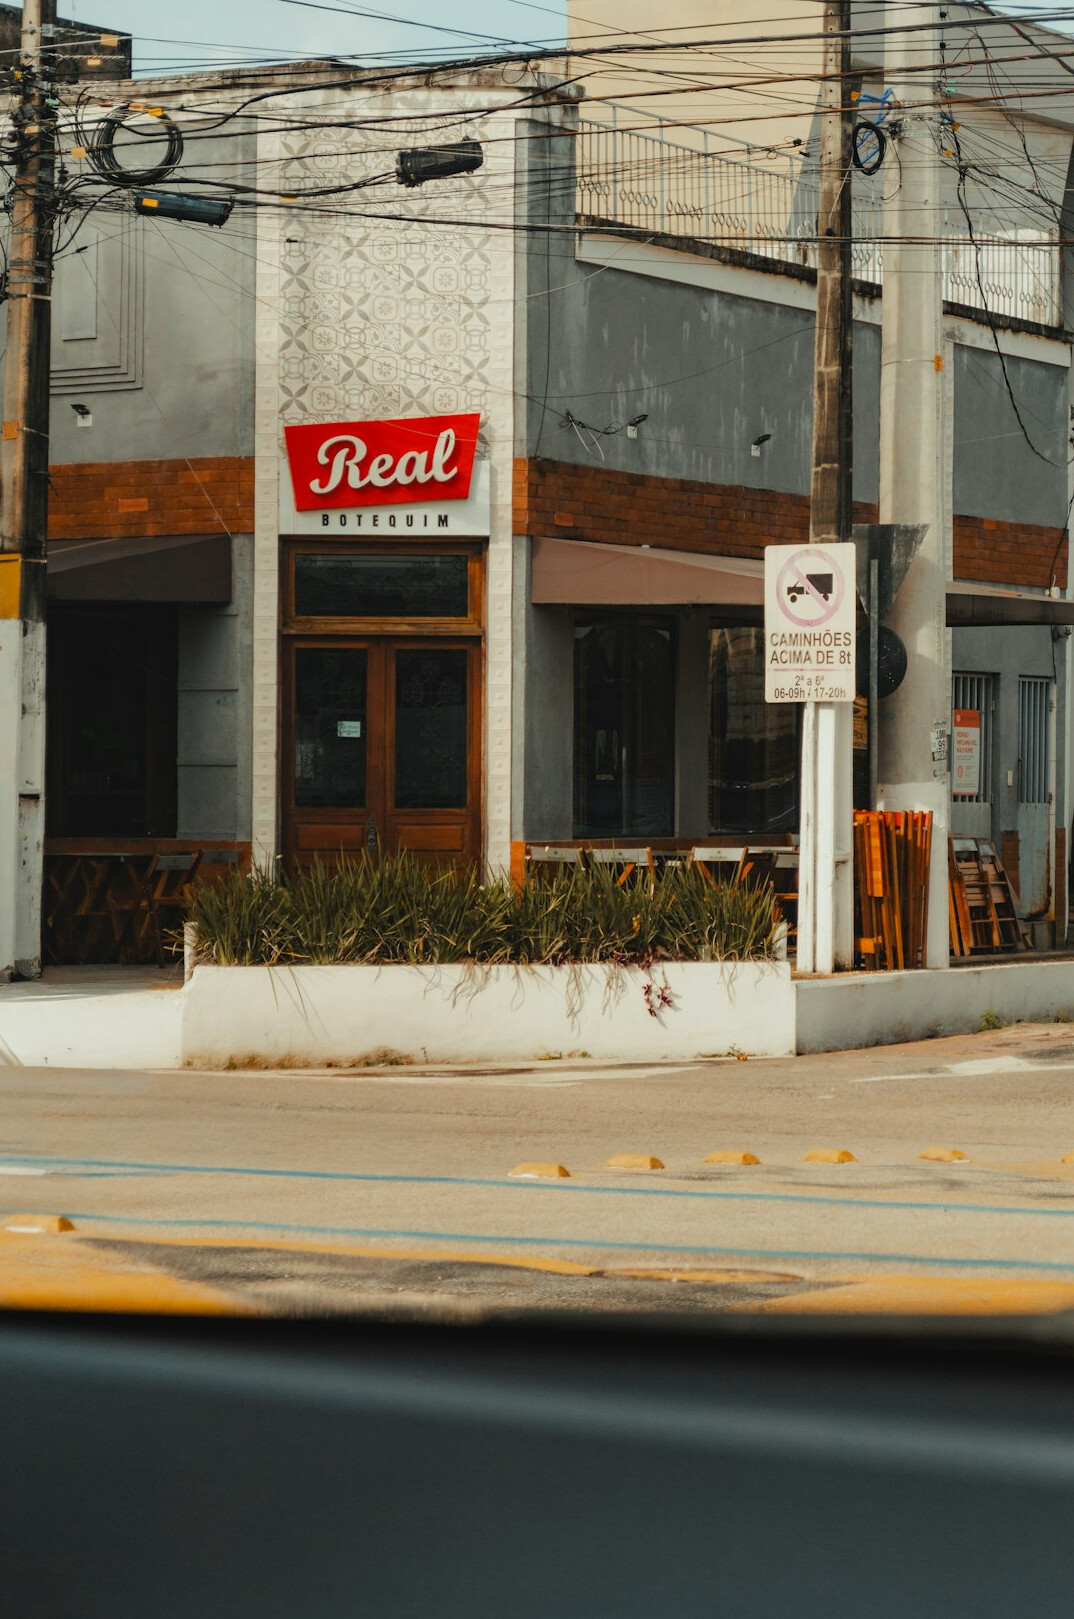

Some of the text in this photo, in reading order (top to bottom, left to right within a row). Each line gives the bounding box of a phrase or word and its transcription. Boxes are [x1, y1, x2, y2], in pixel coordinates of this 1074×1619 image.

[309, 428, 458, 494] Real
[322, 513, 448, 528] BOTEQUIM
[770, 629, 852, 647] CAMINHÕES
[770, 650, 851, 665] ACIMA DE 8t
[807, 678, 812, 686] a
[774, 687, 805, 699] 06-09h
[814, 687, 846, 698] 17-20h
